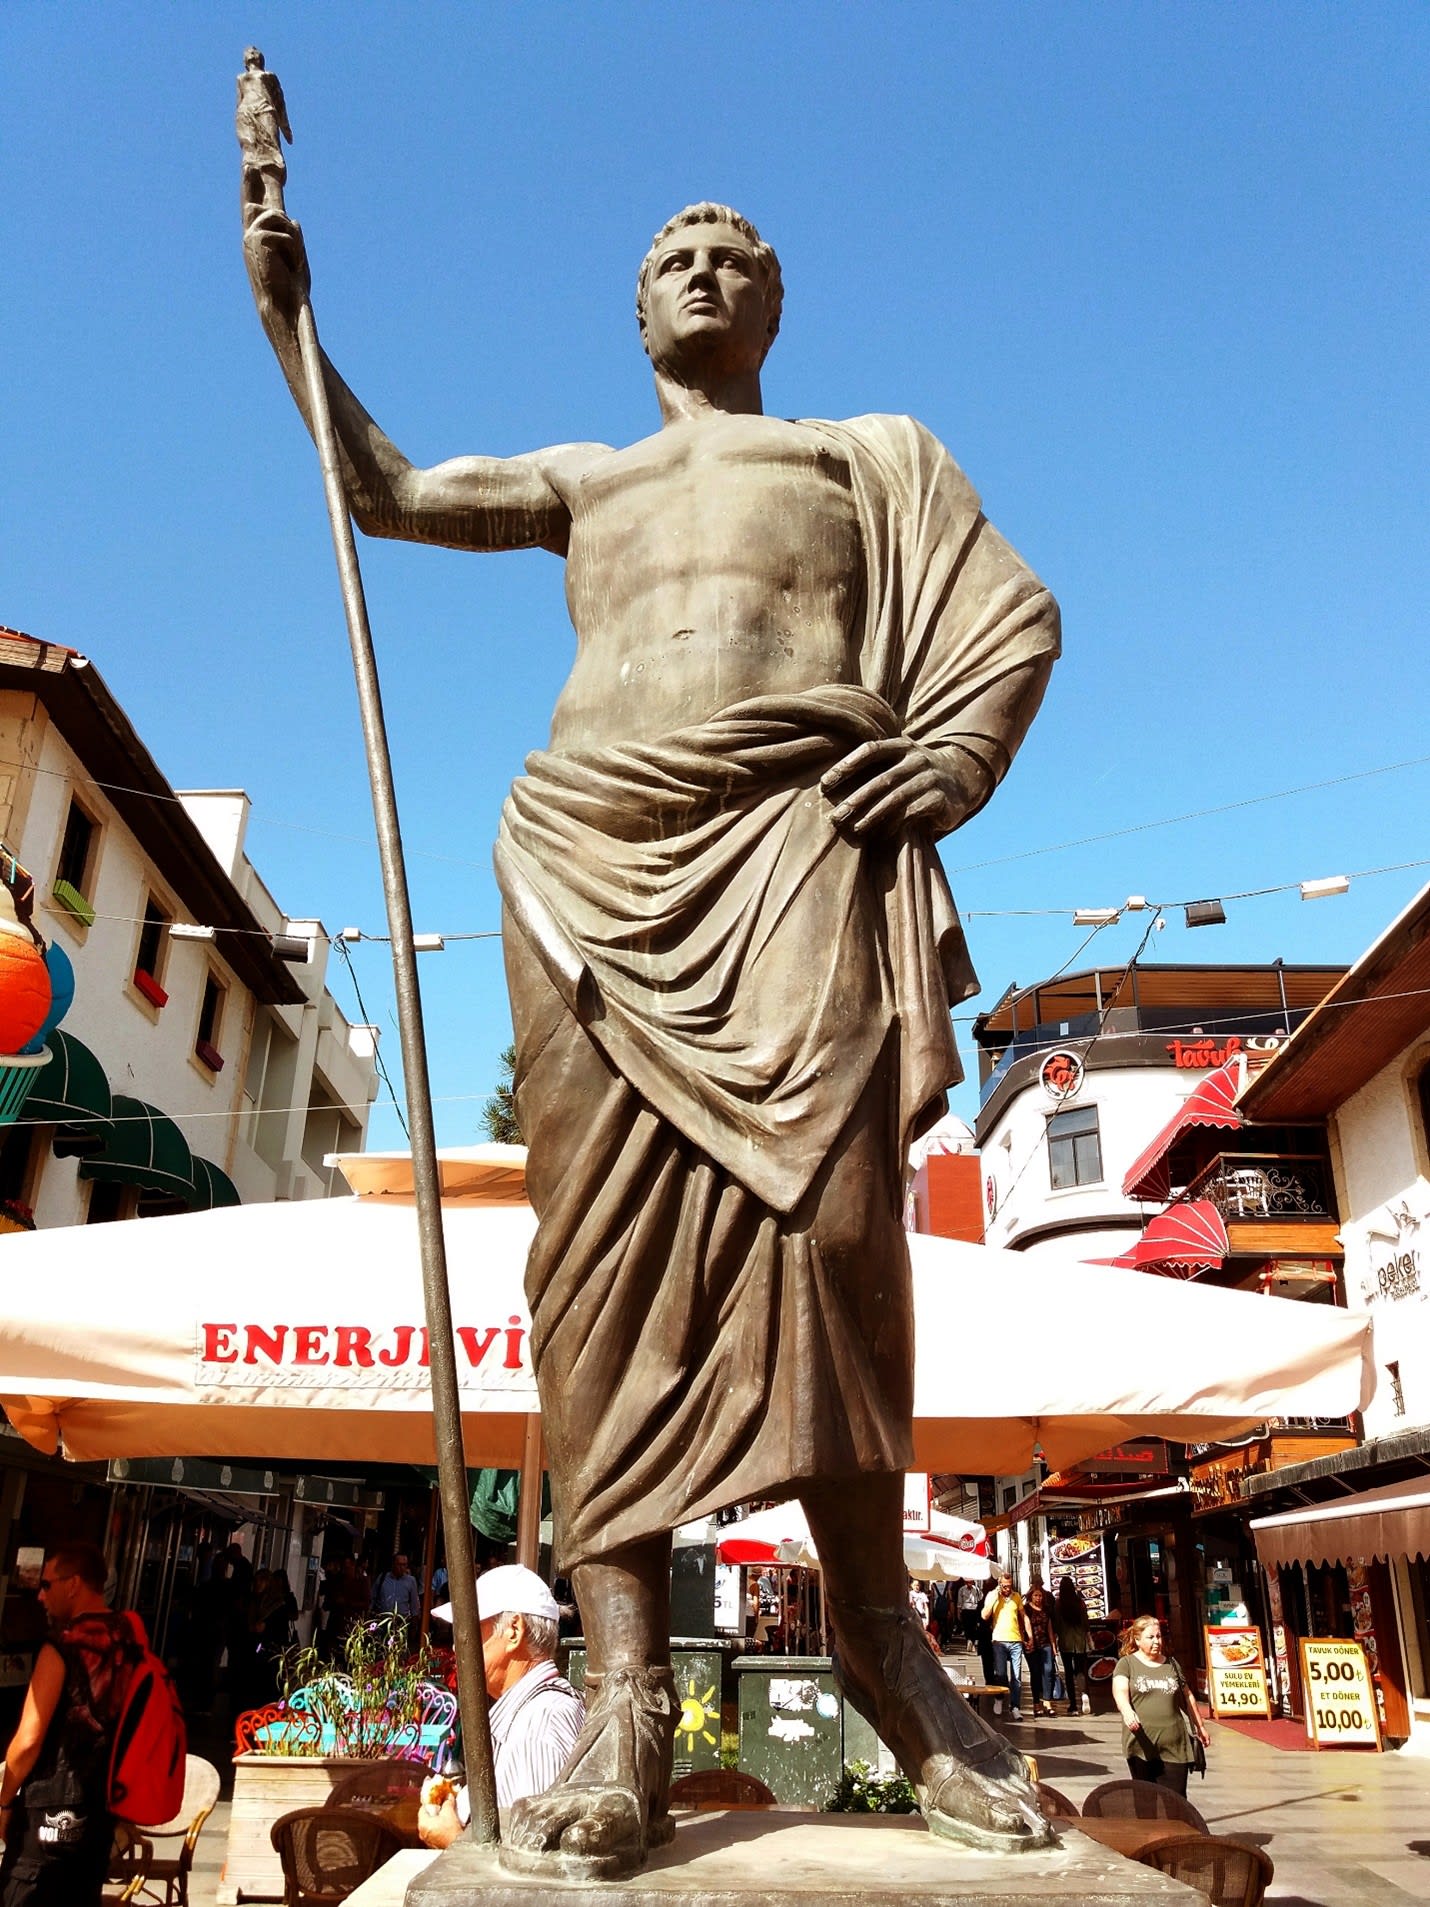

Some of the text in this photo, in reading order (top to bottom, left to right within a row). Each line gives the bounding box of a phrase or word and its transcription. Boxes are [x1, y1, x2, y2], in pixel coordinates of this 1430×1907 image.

[1308, 1645, 1359, 1655] TAVUK DÖNER
[1309, 1661, 1354, 1685] 5,00
[1220, 1692, 1259, 1708] 14,90
[1320, 1690, 1360, 1701] ET DÖNER
[1316, 1709, 1363, 1733] 10,00
